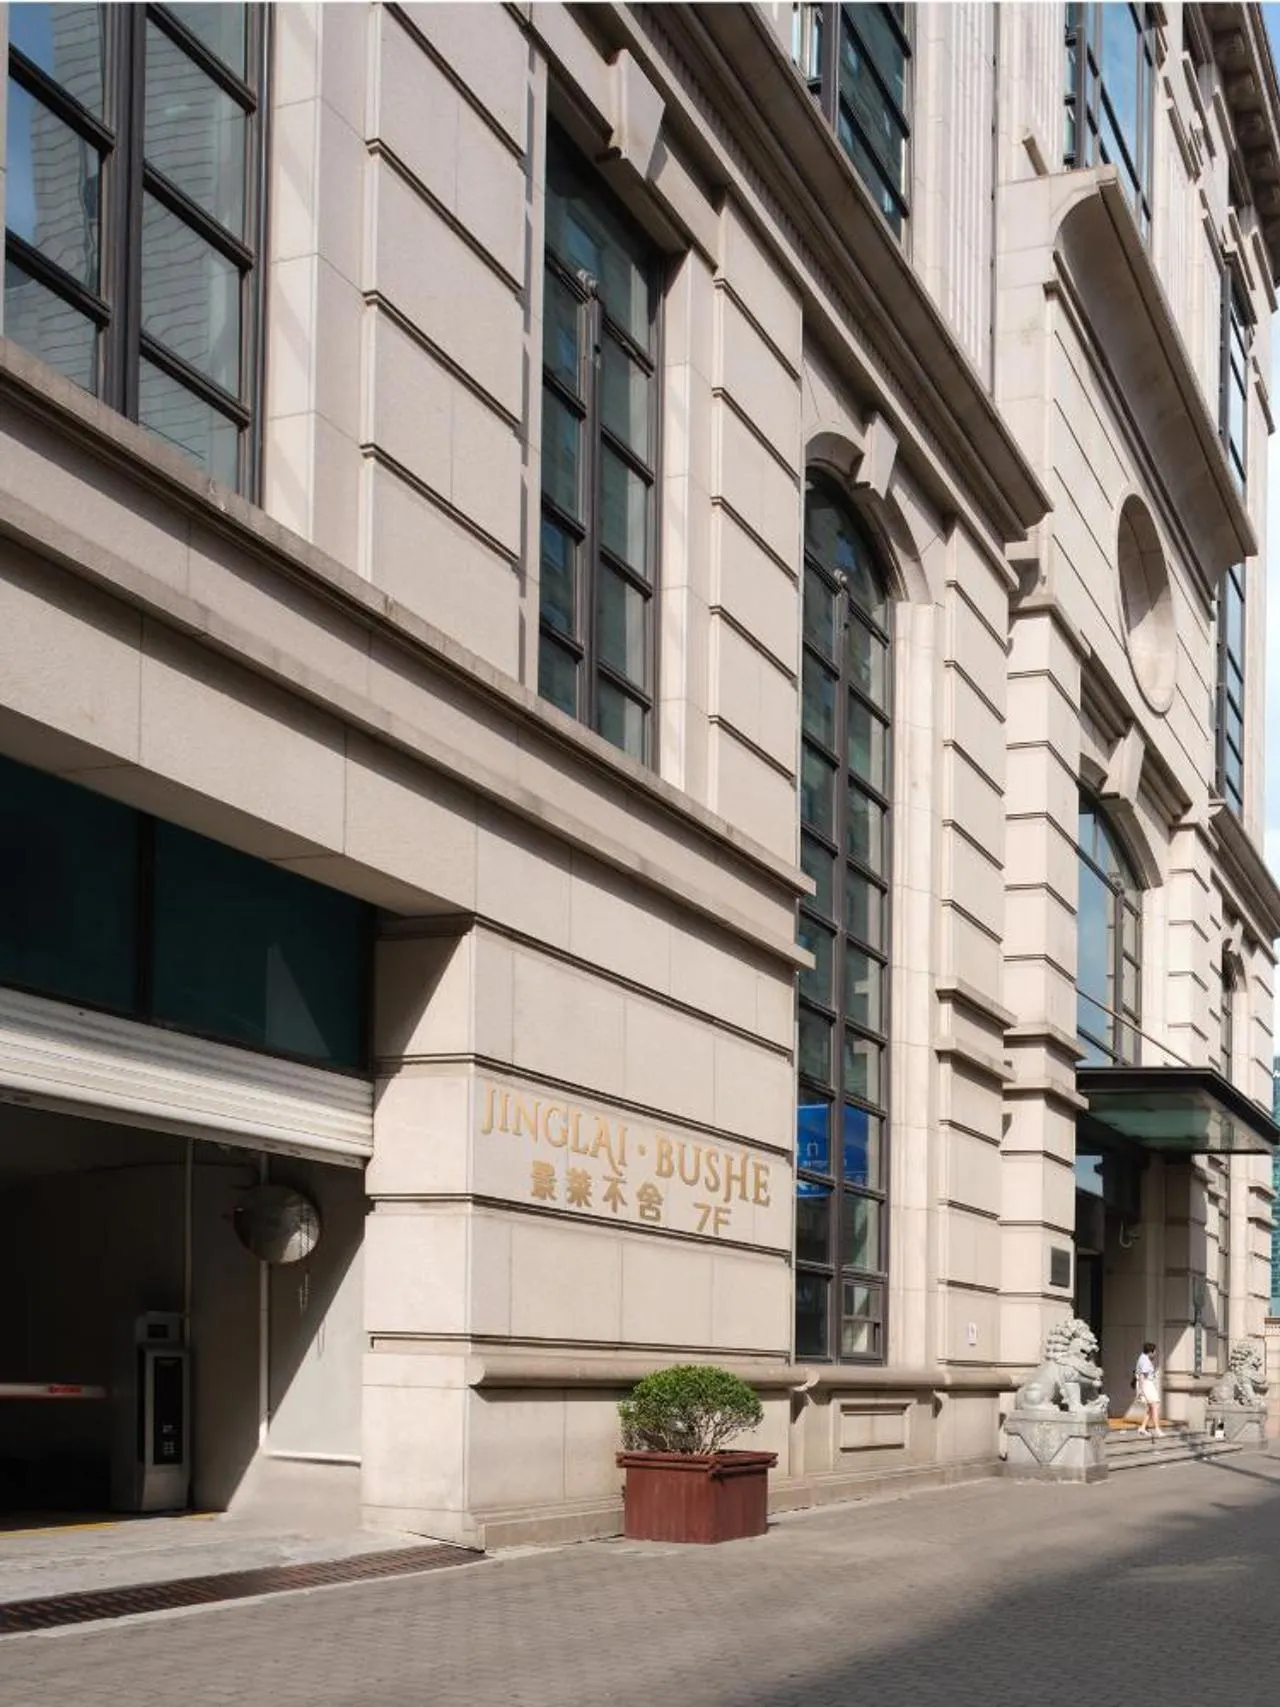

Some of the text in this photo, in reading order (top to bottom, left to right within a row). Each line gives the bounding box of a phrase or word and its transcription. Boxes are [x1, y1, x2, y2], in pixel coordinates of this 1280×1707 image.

[480, 1084, 629, 1176] JINGLAI
[655, 1133, 772, 1207] BUSHE
[693, 1203, 731, 1235] 7F
